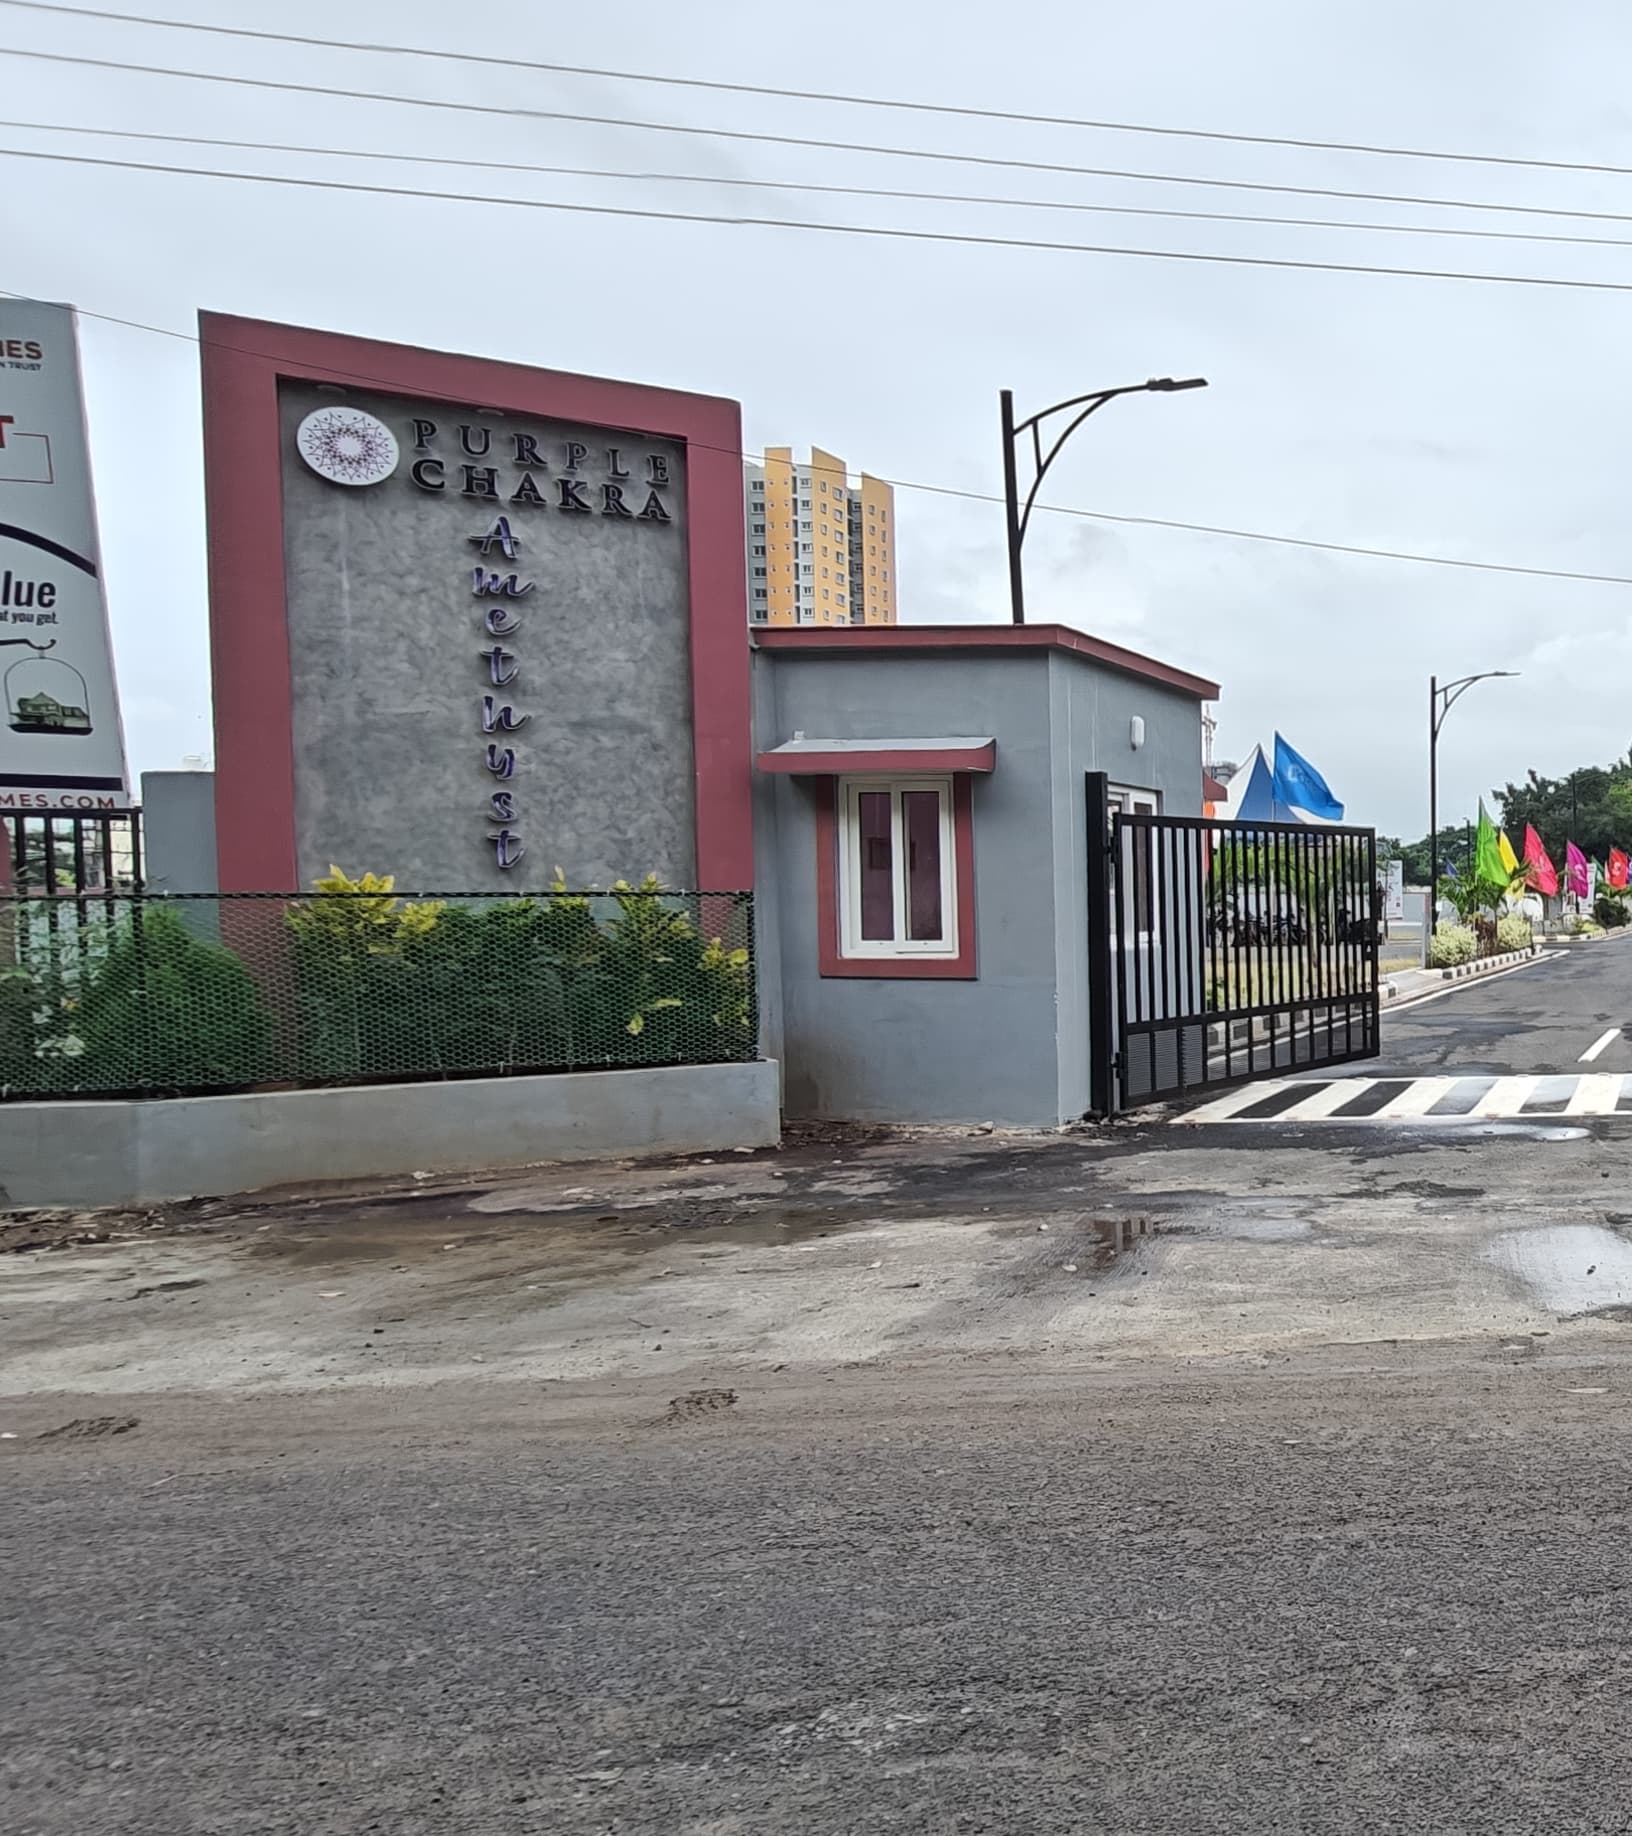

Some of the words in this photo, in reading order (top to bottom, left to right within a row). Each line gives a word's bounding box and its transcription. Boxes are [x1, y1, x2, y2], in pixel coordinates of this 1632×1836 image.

[0, 339, 43, 360] ES
[411, 417, 671, 486] PURPLE
[410, 457, 672, 522] CHAKRA
[468, 514, 536, 871] Amethyst
